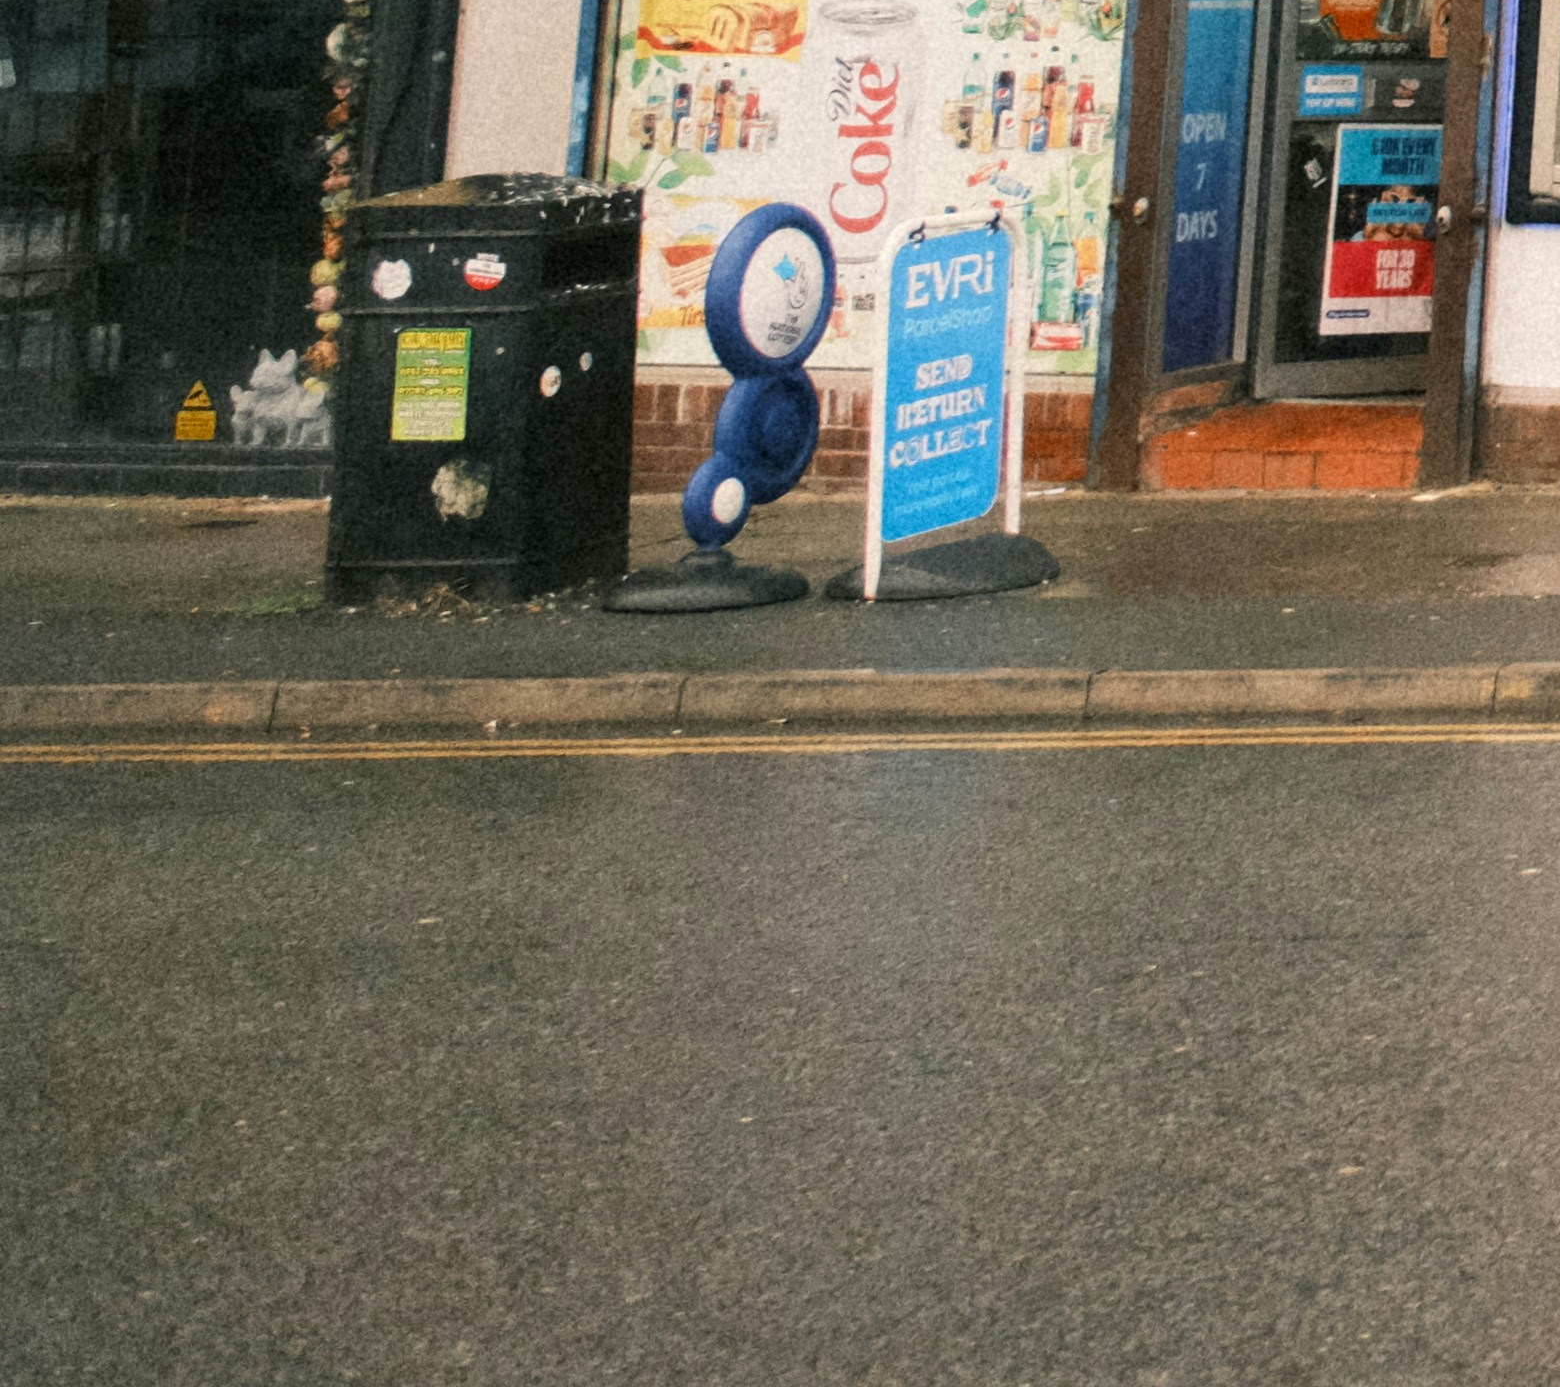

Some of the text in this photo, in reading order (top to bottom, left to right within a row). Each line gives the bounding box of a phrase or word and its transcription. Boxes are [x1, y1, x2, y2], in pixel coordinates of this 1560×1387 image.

[827, 57, 860, 122] Diet
[829, 59, 899, 234] Coke
[1182, 113, 1226, 143] OPEN
[1176, 210, 1218, 242] DAYS
[905, 251, 994, 309] EVRi
[903, 306, 993, 338] ParcelShop
[915, 354, 973, 390] SEND
[896, 384, 988, 432] RETURN
[890, 419, 992, 468] COLLECT
